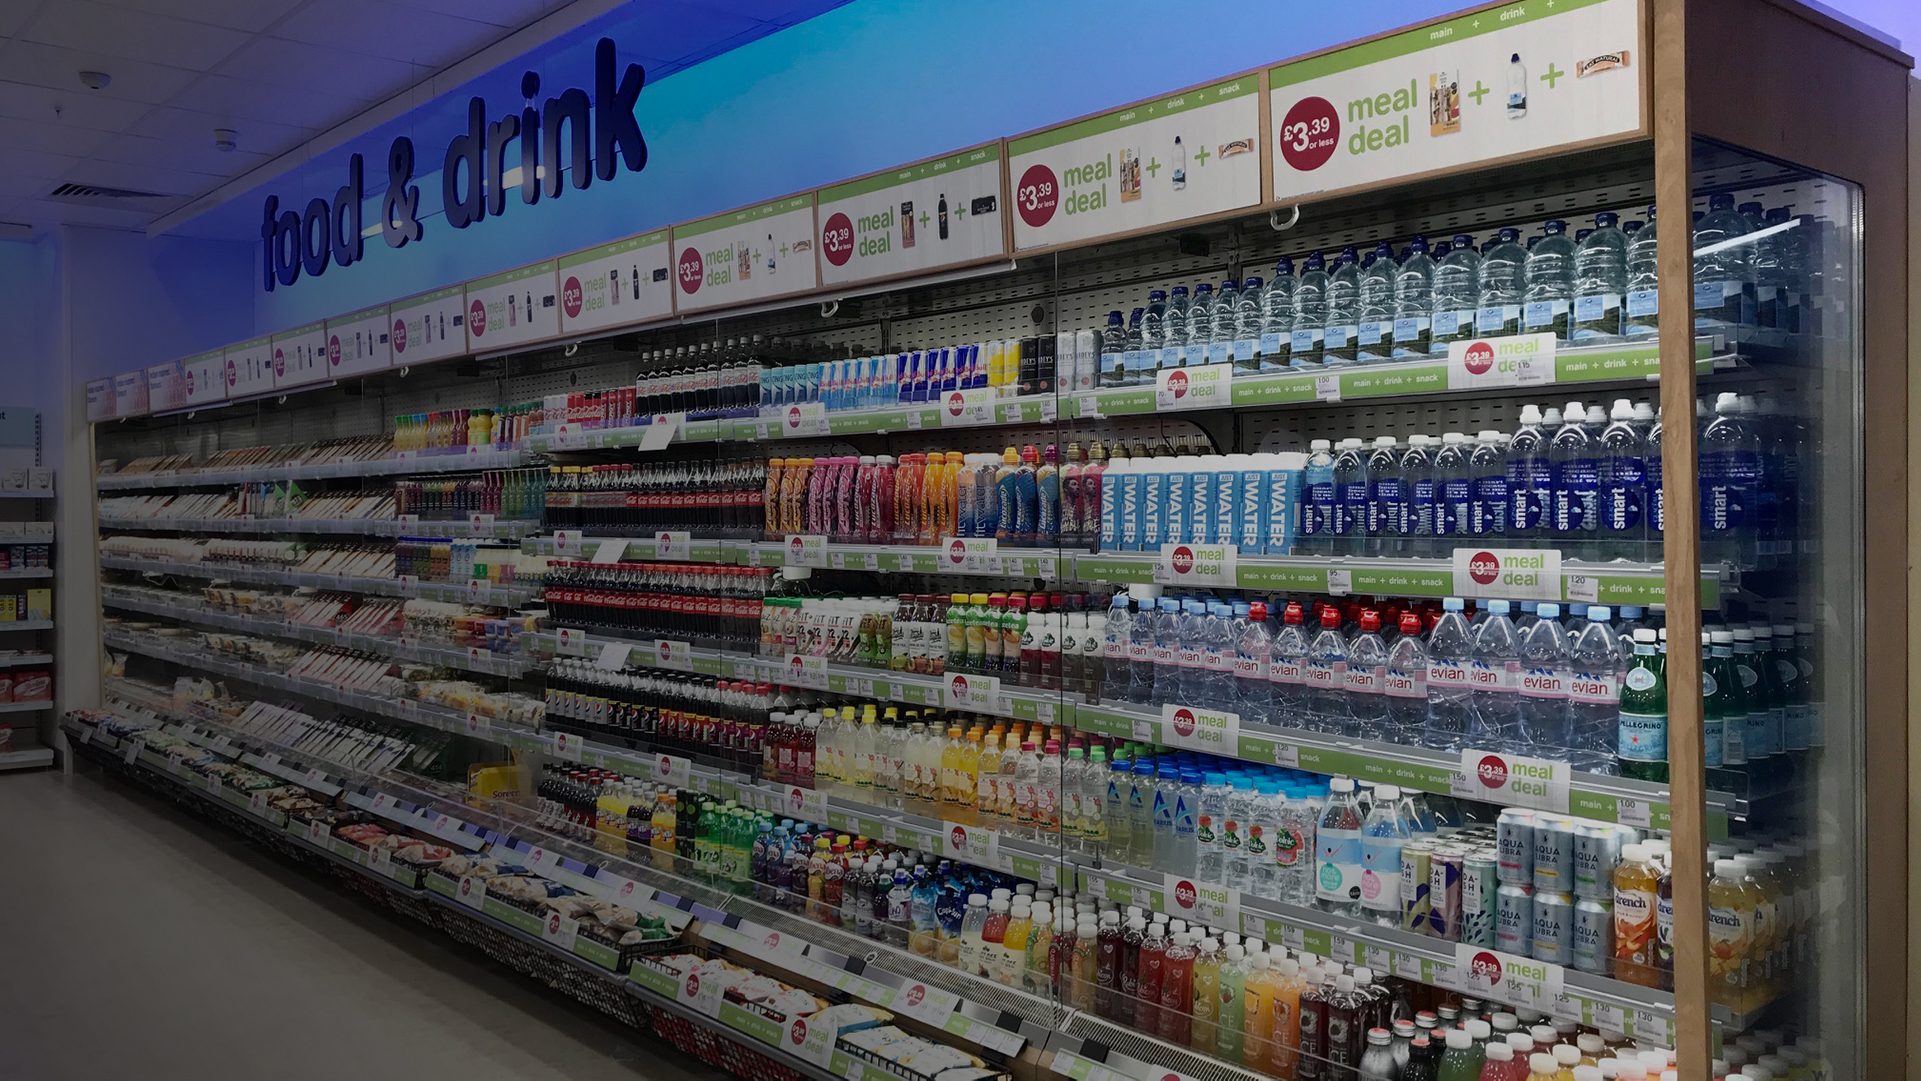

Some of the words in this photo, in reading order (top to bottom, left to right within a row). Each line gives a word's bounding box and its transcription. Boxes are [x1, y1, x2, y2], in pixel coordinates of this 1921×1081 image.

[1430, 26, 1453, 40] main
[1500, 6, 1525, 22] drink
[1119, 111, 1136, 122] main
[1167, 98, 1185, 109] drink
[1218, 83, 1240, 96] snack
[1348, 79, 1417, 123] meal
[1283, 117, 1330, 152] £3.39
[1348, 115, 1409, 155] deal
[1309, 141, 1318, 149] or
[1319, 137, 1334, 147] less
[261, 195, 363, 292] food
[382, 136, 424, 248] &
[443, 37, 647, 229] drink
[899, 171, 912, 180] main
[933, 161, 947, 171] drink
[970, 151, 986, 161] snack
[1064, 153, 1112, 188] meal
[1019, 182, 1052, 211] £3.39
[1044, 199, 1055, 208] less
[1064, 183, 1107, 215] deal
[858, 205, 894, 233] meal
[825, 228, 849, 252] £3.39
[858, 231, 891, 257] deal
[705, 243, 734, 266] meal
[680, 260, 699, 281] £3.39
[706, 265, 731, 287] deal
[584, 272, 607, 291] meal
[487, 297, 506, 315] meal
[585, 294, 605, 312] deal
[407, 317, 423, 332] meal
[487, 318, 504, 332] deal
[408, 334, 422, 348] deal
[1499, 339, 1539, 354] meal
[1465, 351, 1490, 366] £3.39
[1566, 363, 1588, 371] main
[1604, 359, 1627, 368] drink
[1191, 368, 1220, 382] meal
[1353, 379, 1371, 387] main
[1384, 376, 1403, 385] drink
[1416, 373, 1439, 383] snack
[1191, 384, 1216, 397] deal
[1238, 387, 1254, 396] main
[1265, 385, 1281, 394] drink
[1293, 383, 1313, 392] snack
[966, 392, 987, 403] meal
[1102, 483, 1114, 542] WATER
[1123, 483, 1136, 543] WATER
[1145, 483, 1158, 543] WATER
[1168, 483, 1182, 544] WATER
[1192, 482, 1207, 544] WATER
[1217, 481, 1233, 544] WATER
[1243, 481, 1259, 545] WATER
[1269, 481, 1286, 546] WATER
[1515, 489, 1526, 529] smart
[1556, 490, 1568, 531] smart
[1611, 488, 1625, 530] smart
[1714, 485, 1727, 530] smart
[1305, 504, 1313, 534] smart
[1335, 504, 1343, 534] smart
[1369, 501, 1377, 532] smart
[1400, 502, 1408, 533] smart
[1436, 502, 1445, 535] smart
[1474, 501, 1482, 533] smart
[804, 538, 820, 547] meal
[967, 542, 988, 552] meal
[1196, 548, 1224, 560] meal
[1503, 553, 1544, 569] meal
[1196, 563, 1221, 575] deal
[1471, 561, 1495, 575] £3.39
[1270, 573, 1286, 581] drink
[1298, 574, 1318, 582] snack
[1358, 576, 1376, 584] main
[1389, 577, 1408, 585] drink
[1421, 578, 1443, 586] snack
[1503, 571, 1539, 586] deal
[1610, 585, 1633, 593] drink
[1234, 660, 1258, 671] evian
[1270, 665, 1299, 676] evian
[1306, 668, 1331, 680] evian
[1346, 673, 1373, 685] evian
[1431, 667, 1465, 680] evian
[970, 679, 991, 690] meal
[1386, 677, 1412, 689] evian
[1524, 676, 1561, 690] evian
[1572, 681, 1608, 695] evian
[1094, 718, 1107, 726] main
[1116, 722, 1129, 730] drink
[1198, 714, 1227, 728] meal
[1197, 729, 1222, 743] deal
[1245, 744, 1261, 752] main
[1300, 754, 1320, 762] snack
[1365, 764, 1383, 774] main
[1396, 768, 1415, 779] drink
[1479, 764, 1503, 779] £3.39
[1512, 762, 1553, 779] meal
[1511, 779, 1547, 797] deal
[804, 794, 821, 804] meal
[1580, 800, 1601, 810] main
[969, 831, 990, 845] meal
[1499, 838, 1524, 848] AQUA
[1500, 847, 1521, 856] LIBRA
[1536, 845, 1560, 855] AQUA
[1576, 852, 1599, 862] AQUA
[1536, 853, 1557, 863] LIBRA
[1200, 888, 1228, 904] meal
[1615, 895, 1646, 908] drench
[1498, 911, 1521, 920] AQUA
[1535, 919, 1560, 930] AQUA
[1576, 926, 1600, 937] AQUA
[1535, 927, 1558, 938] LIBRA
[1473, 959, 1498, 974] £3.39
[1506, 961, 1546, 981] meal
[809, 1027, 829, 1042] meal
[804, 1040, 824, 1055] deal
